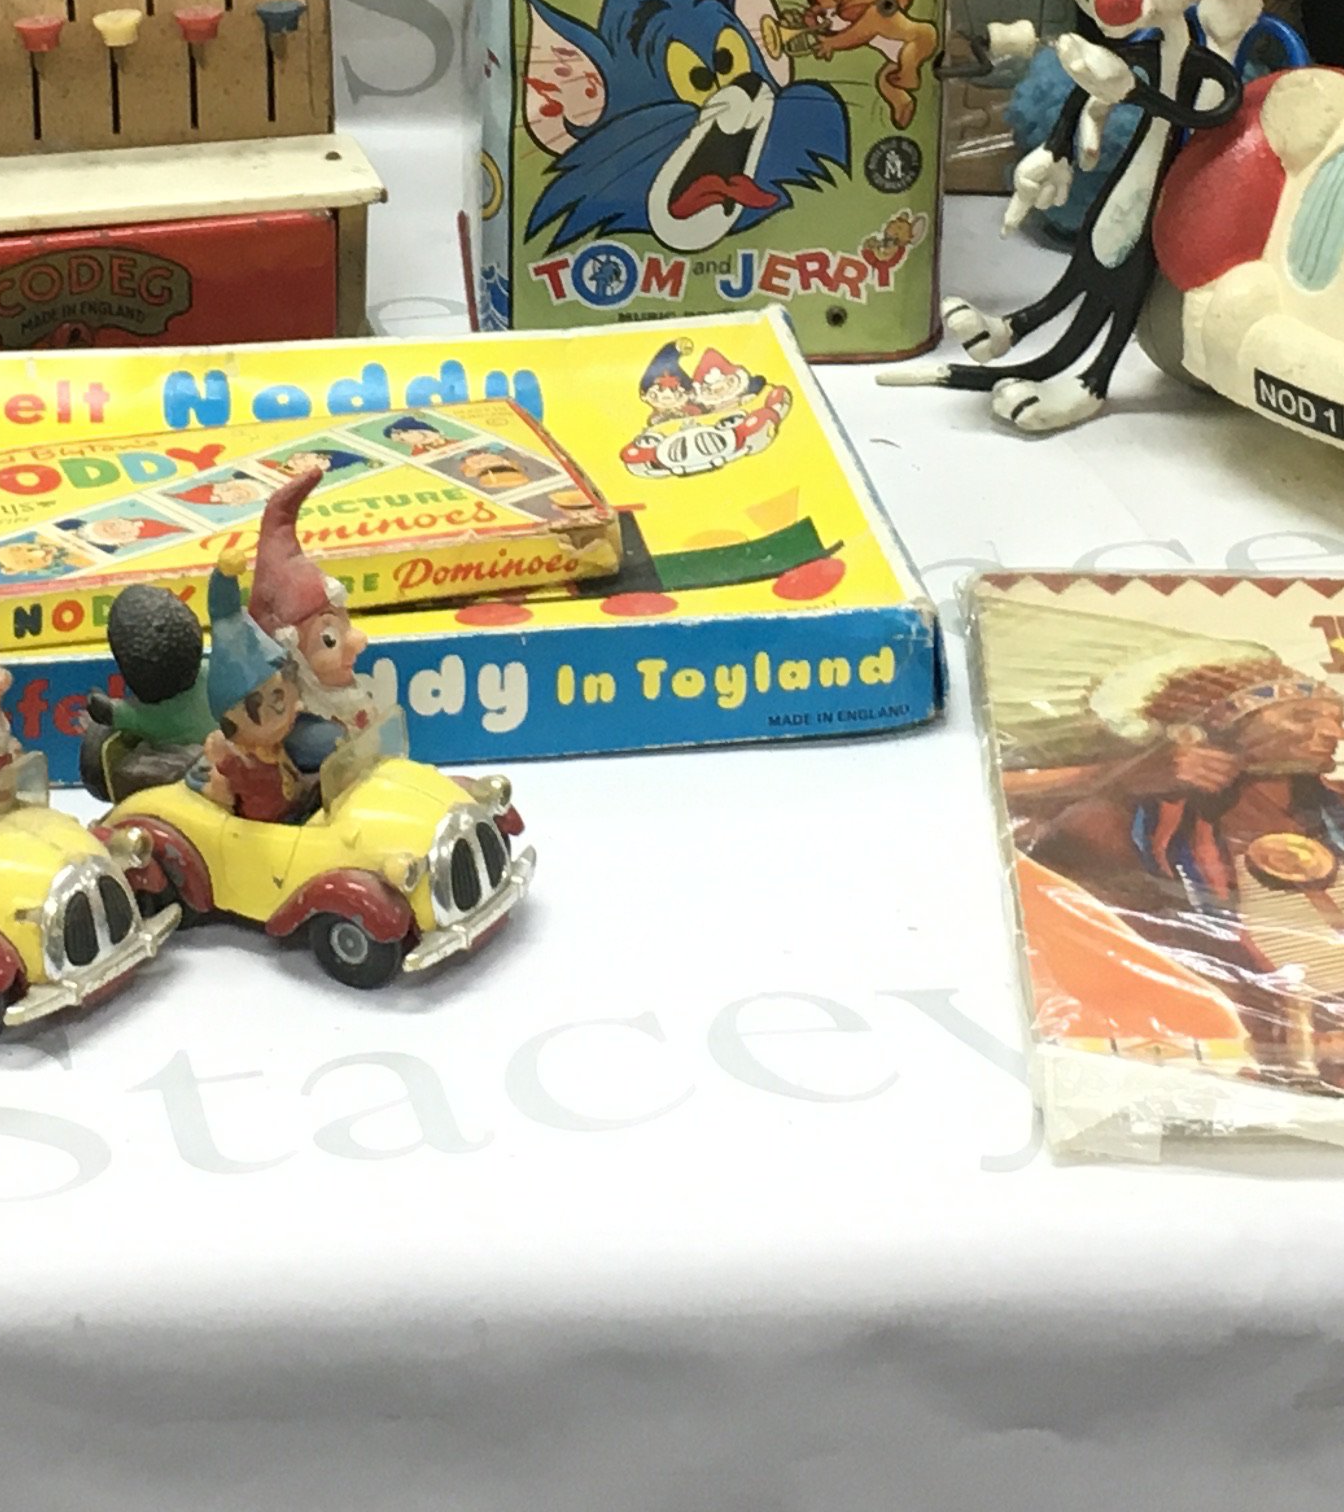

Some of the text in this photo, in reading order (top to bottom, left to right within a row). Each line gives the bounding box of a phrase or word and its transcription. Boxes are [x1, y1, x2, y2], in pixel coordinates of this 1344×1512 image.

[531, 243, 907, 307] TOM and JERRY
[20, 301, 146, 335] MADE IN ENGLAND
[163, 359, 544, 430] Noddy
[1258, 378, 1337, 433] NOD 1
[295, 487, 468, 520] PICTURE
[557, 664, 615, 708] In
[637, 646, 896, 710] Toyland
[768, 703, 911, 727] MADE IN ENGLAND
